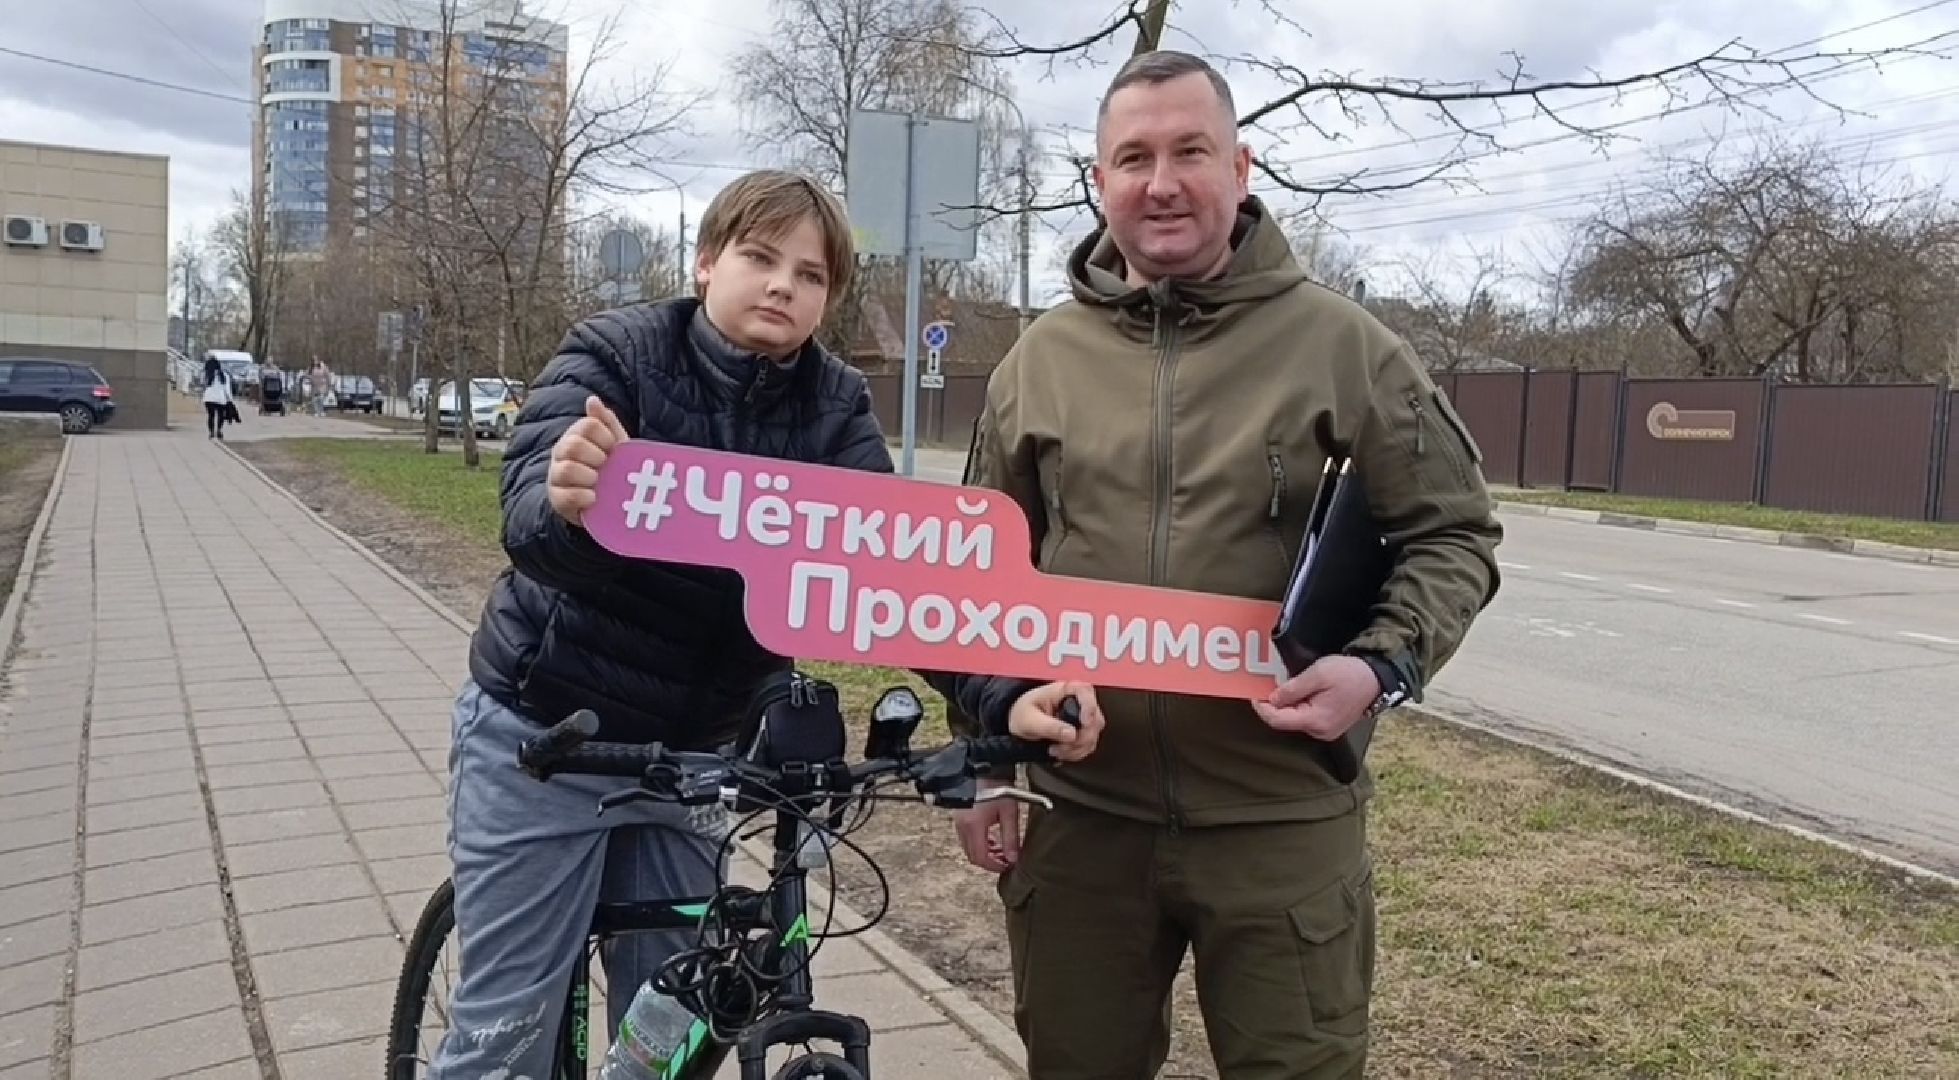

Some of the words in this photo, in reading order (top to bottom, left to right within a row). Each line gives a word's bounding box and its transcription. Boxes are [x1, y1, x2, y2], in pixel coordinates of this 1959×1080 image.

[621, 458, 994, 570] #Чёткий
[787, 561, 1288, 686] Проходимец
[576, 1015, 587, 1061] ACID
